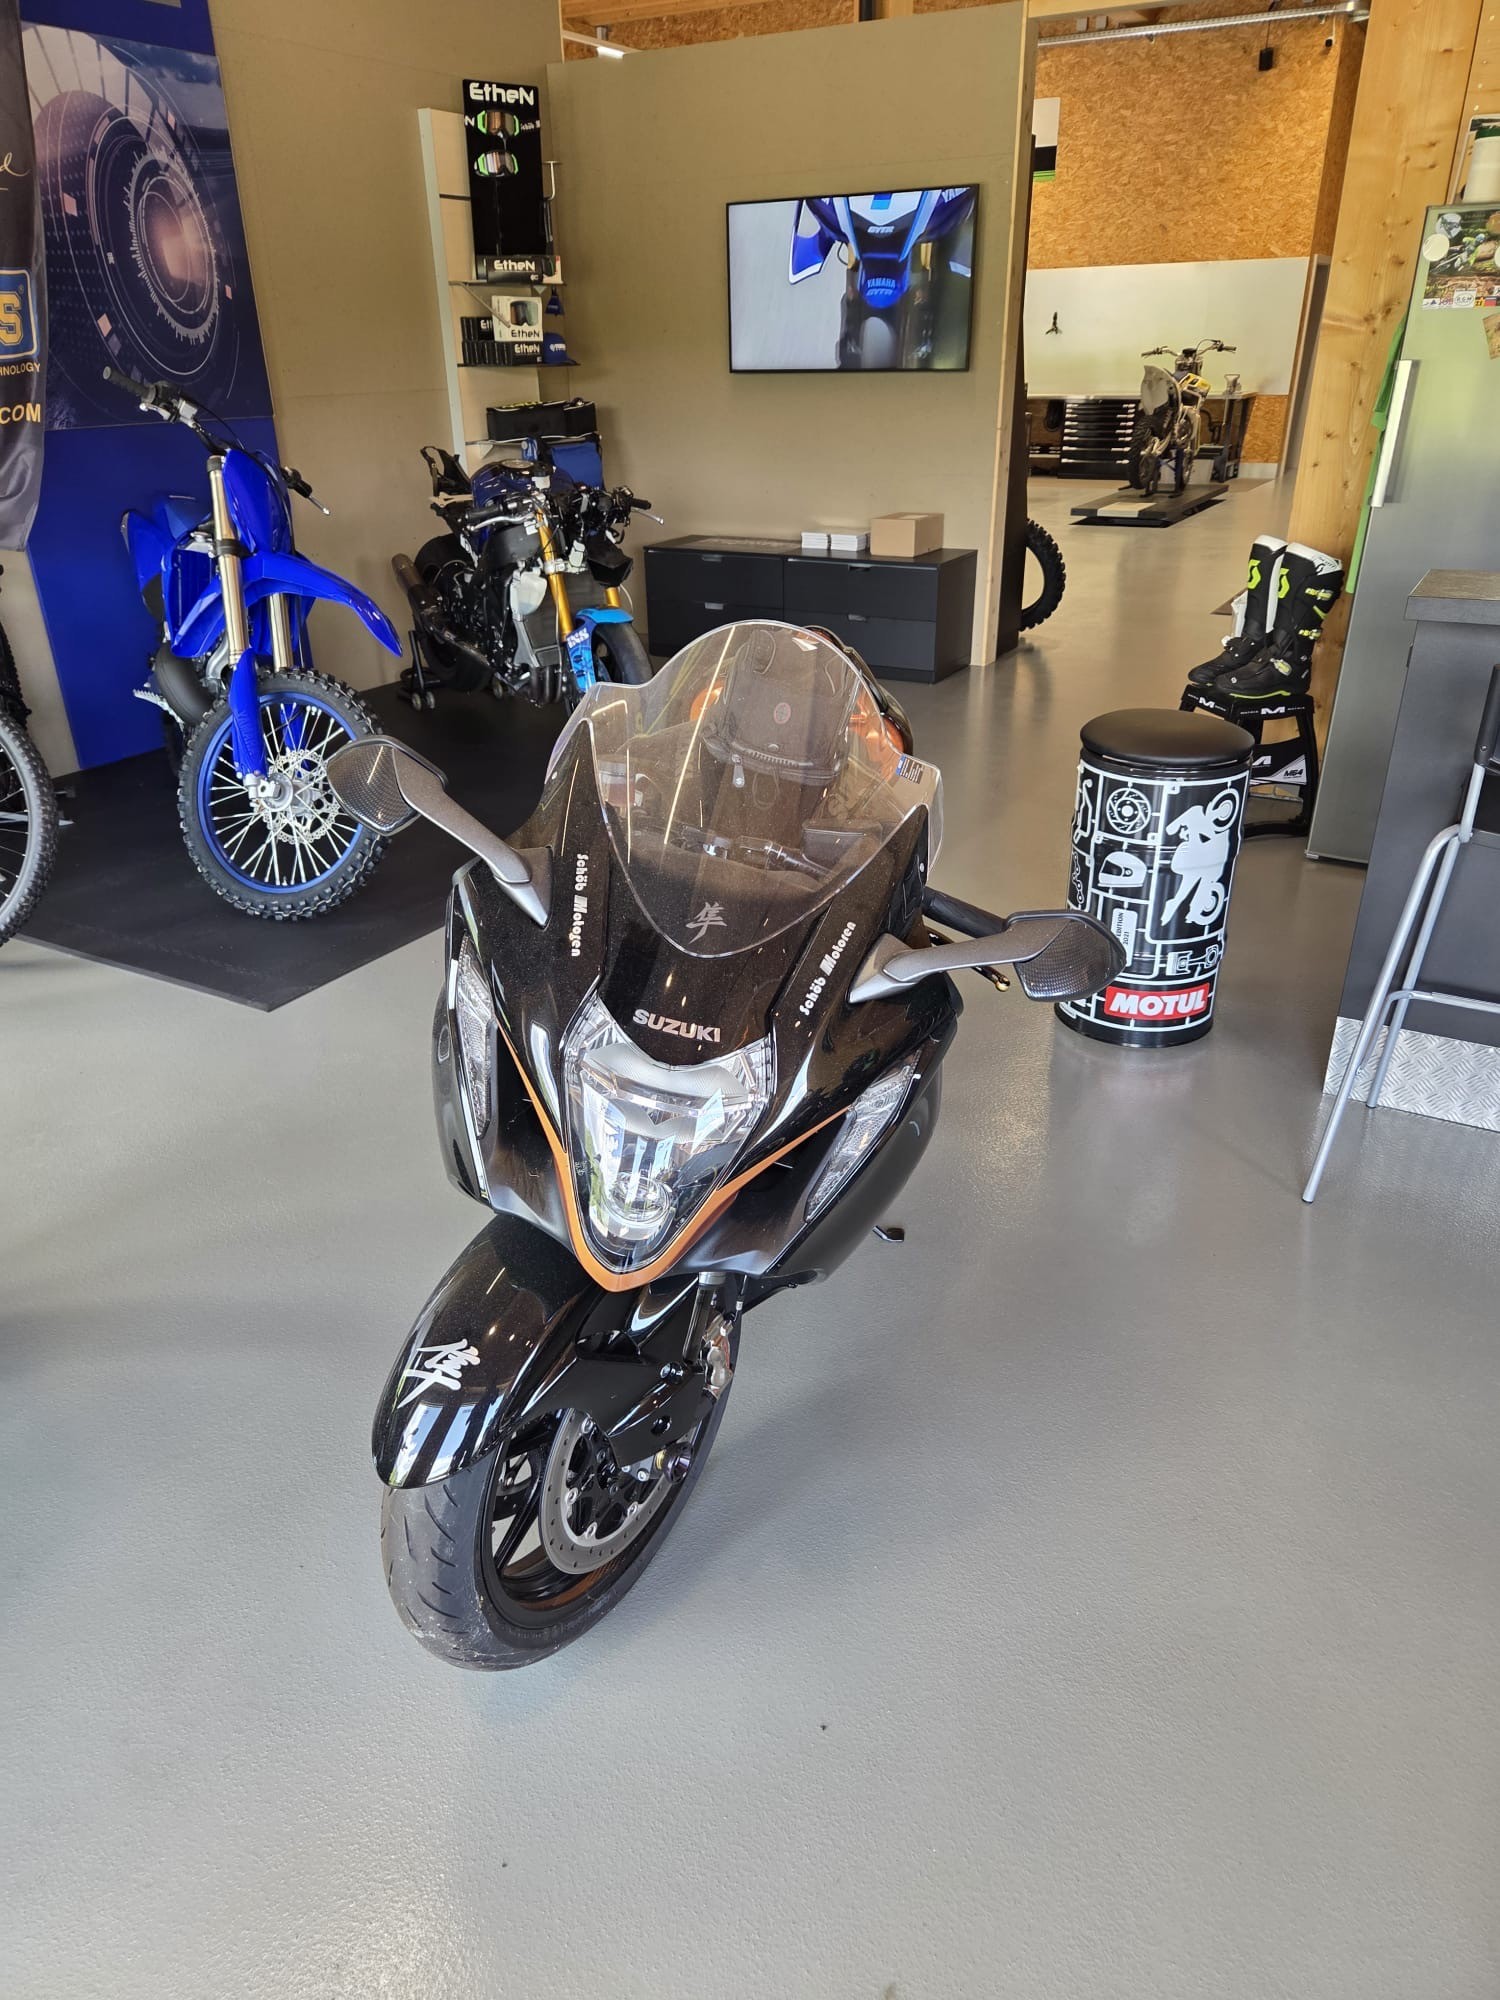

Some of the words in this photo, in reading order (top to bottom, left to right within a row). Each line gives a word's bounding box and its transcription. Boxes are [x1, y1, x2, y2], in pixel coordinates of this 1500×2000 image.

[469, 82, 534, 106] EtheN
[494, 260, 536, 271] EtheN
[867, 278, 896, 289] YAMAHA
[511, 329, 541, 338] EtheN
[574, 853, 589, 891] Schöb
[685, 901, 728, 945] 隼
[799, 976, 826, 1016] Schöb
[819, 921, 857, 977] Motoren
[1109, 989, 1205, 1016] MOTUL
[632, 1008, 721, 1043] SUZUKI
